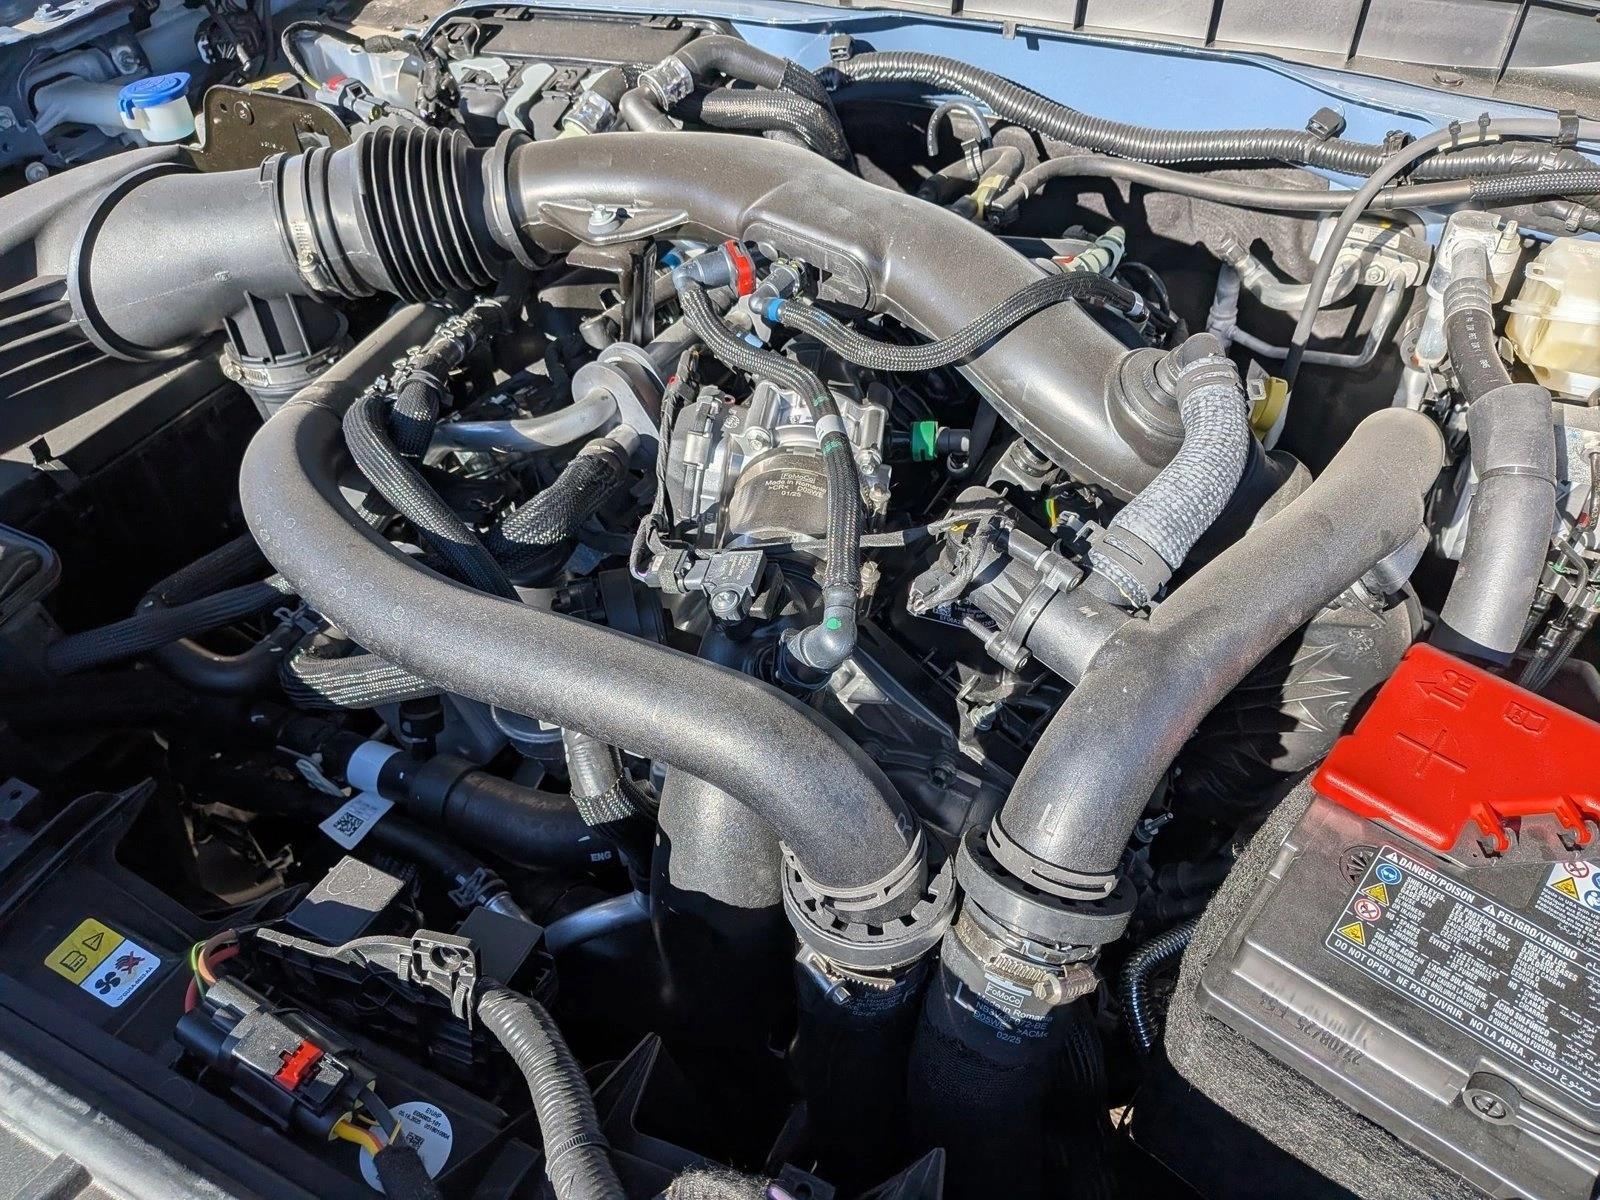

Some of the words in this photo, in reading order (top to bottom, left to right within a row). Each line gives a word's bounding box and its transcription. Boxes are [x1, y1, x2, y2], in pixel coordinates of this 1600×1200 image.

[1397, 856, 1475, 903] DANGER/POISON
[1405, 876, 1429, 892] SHIELD
[1397, 892, 1416, 905] CAUSE
[1399, 886, 1420, 901] GASES
[1419, 897, 1433, 908] CAN
[1402, 881, 1437, 903] EXPLOSIVE
[1384, 911, 1395, 920] NO
[1391, 902, 1400, 910] OR
[1393, 897, 1426, 918] BLINDNESS
[1395, 924, 1418, 940] FLAMES
[1398, 918, 1421, 935] SPARKS
[1447, 913, 1483, 936] EXPLOSIFS
[1450, 907, 1464, 918] LES
[1483, 925, 1497, 936] LES
[1495, 932, 1511, 944] GAZ
[1495, 909, 1579, 960] PELIGRO/VENENO
[1373, 931, 1401, 951] SULFURIC
[1399, 946, 1414, 958] ACID
[1392, 929, 1418, 947] SMOKING
[1370, 937, 1389, 952] CAUSE
[1387, 947, 1418, 969] BLINDNESS
[1375, 948, 1396, 964] SEVERE
[1452, 956, 1465, 966] LES
[1455, 950, 1467, 961] LES
[1523, 940, 1554, 961] PROTEJA
[1553, 957, 1568, 969] LOS
[1449, 961, 1458, 970] DE
[1517, 951, 1560, 978] EXPLOSIVOS
[1540, 957, 1554, 969] LOS
[1554, 964, 1578, 982] GASES
[986, 985, 1021, 1005] FoMoCo
[1449, 974, 1487, 1001] SULFURIQUE
[1507, 980, 1518, 990] NO
[1333, 938, 1348, 951] DO
[1347, 946, 1367, 962] NOT
[1365, 957, 1394, 978] OPEN.
[1395, 974, 1409, 987] NE
[1408, 982, 1428, 998] PAS
[1427, 993, 1466, 1021] OUVRIR.
[1468, 1017, 1483, 1031] NO
[1483, 1026, 1498, 1040] LA
[1496, 1034, 1528, 1058] ABRA.
[1520, 995, 1546, 1013] FLAMAS
[1522, 989, 1549, 1008] CHISPAS
[1002, 1005, 1011, 1015] in
[1517, 1001, 1549, 1022] CIGARROS
[1490, 1007, 1510, 1022] PUEDE
[1508, 1018, 1531, 1035] CAUSAR
[1529, 1030, 1558, 1051] CEGUERA
